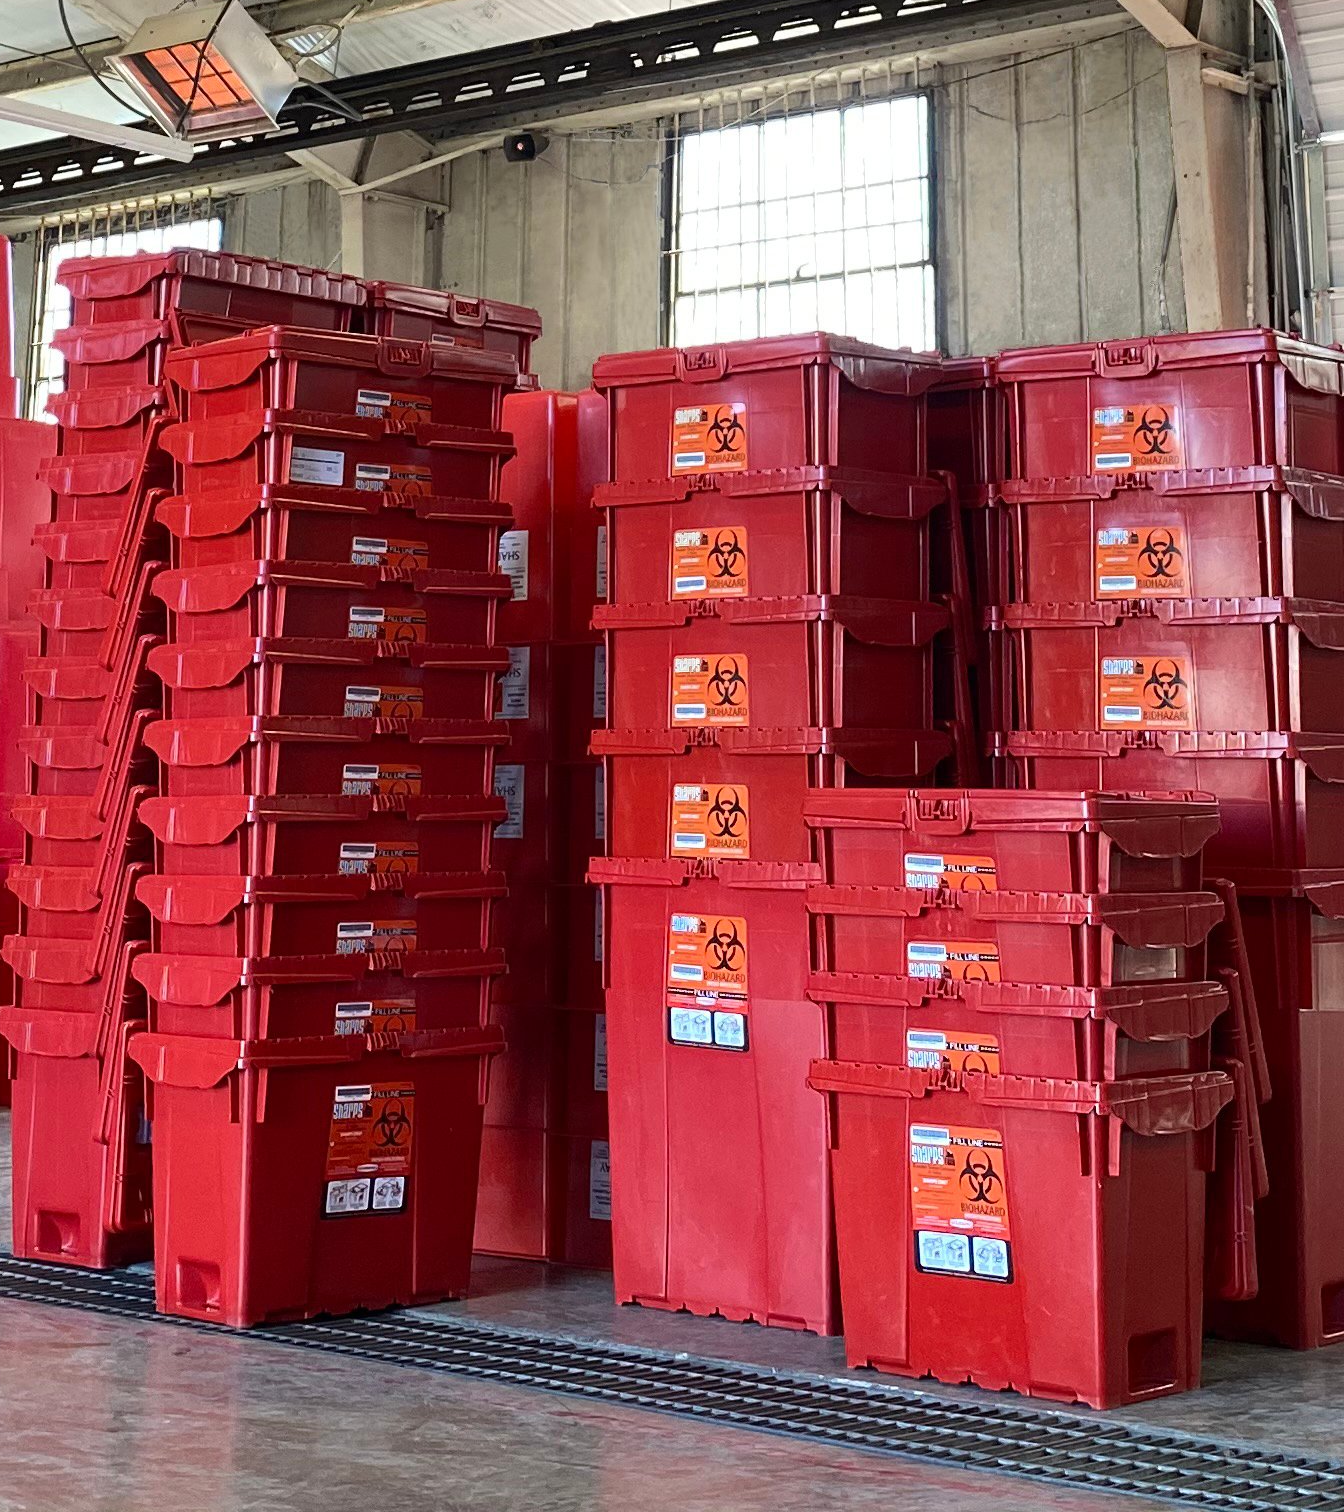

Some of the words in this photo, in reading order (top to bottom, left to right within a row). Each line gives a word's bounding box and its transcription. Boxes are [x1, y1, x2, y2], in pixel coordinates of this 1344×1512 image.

[406, 401, 416, 409] LINE
[706, 453, 746, 464] BIOHAZARD
[1133, 455, 1179, 466] BIOHAZARD
[393, 472, 404, 480] FILL
[389, 546, 400, 554] FILL
[706, 577, 746, 589] BIOHAZARD
[387, 615, 398, 623] FILL
[383, 693, 395, 701] FILL
[706, 707, 747, 717] BIOHAZARD
[706, 838, 747, 849] BIOHAZARD
[378, 849, 390, 857] FILL
[947, 864, 963, 873] FILL
[964, 865, 977, 873] LINE
[376, 927, 387, 935] FILL
[388, 927, 401, 935] LINE
[949, 952, 963, 961] FILL
[964, 953, 979, 961] LINE
[705, 970, 746, 983] BIOHAZARD
[375, 1007, 386, 1015] FILL
[388, 1007, 400, 1015] LINE
[950, 1042, 964, 1051] FILL
[965, 1043, 980, 1052] LINE
[373, 1090, 385, 1098] FILL
[387, 1090, 399, 1098] LINE
[953, 1137, 968, 1146] FILL
[969, 1139, 983, 1147] LINE
[960, 1202, 1005, 1217] BIOHAZARD
